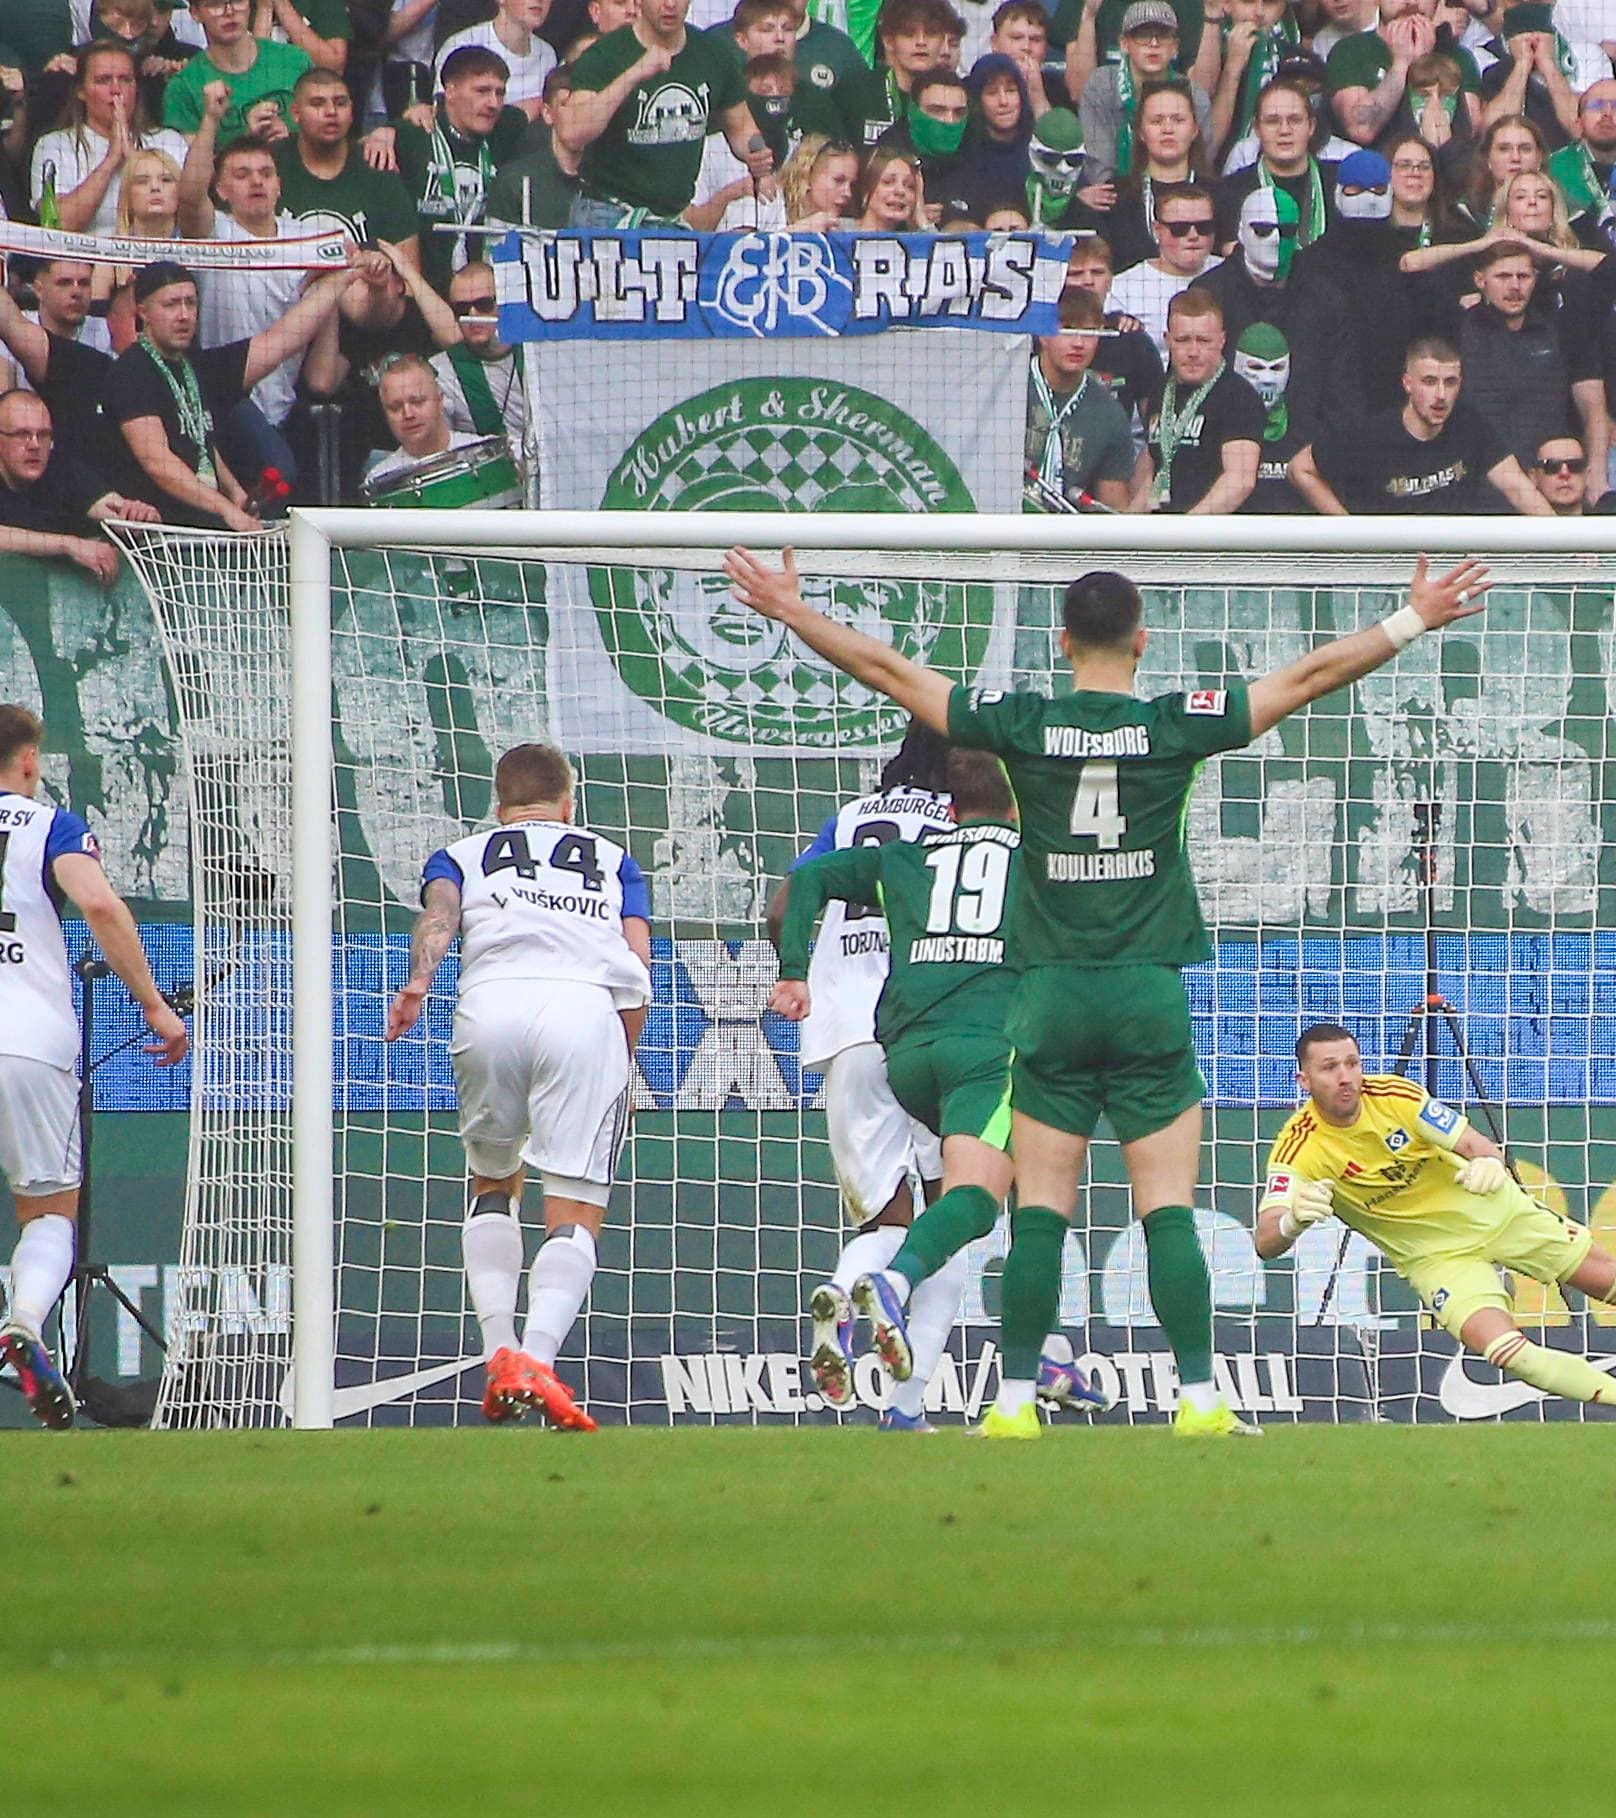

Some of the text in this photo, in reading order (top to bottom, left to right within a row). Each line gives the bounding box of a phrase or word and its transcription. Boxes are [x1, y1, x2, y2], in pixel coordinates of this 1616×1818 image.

[620, 393, 745, 498] Hubert
[760, 390, 785, 418] &
[798, 386, 947, 506] Sherman
[1044, 724, 1151, 758] WOLFSBURG
[12, 810, 37, 827] SV
[1069, 761, 1127, 851] 4
[482, 829, 606, 892] 44
[1046, 850, 1155, 882] KOULIERAKIS
[510, 886, 611, 921] VUŠKOVIĆ
[923, 840, 1012, 935] 19
[908, 936, 1006, 965] LINDSTRØM
